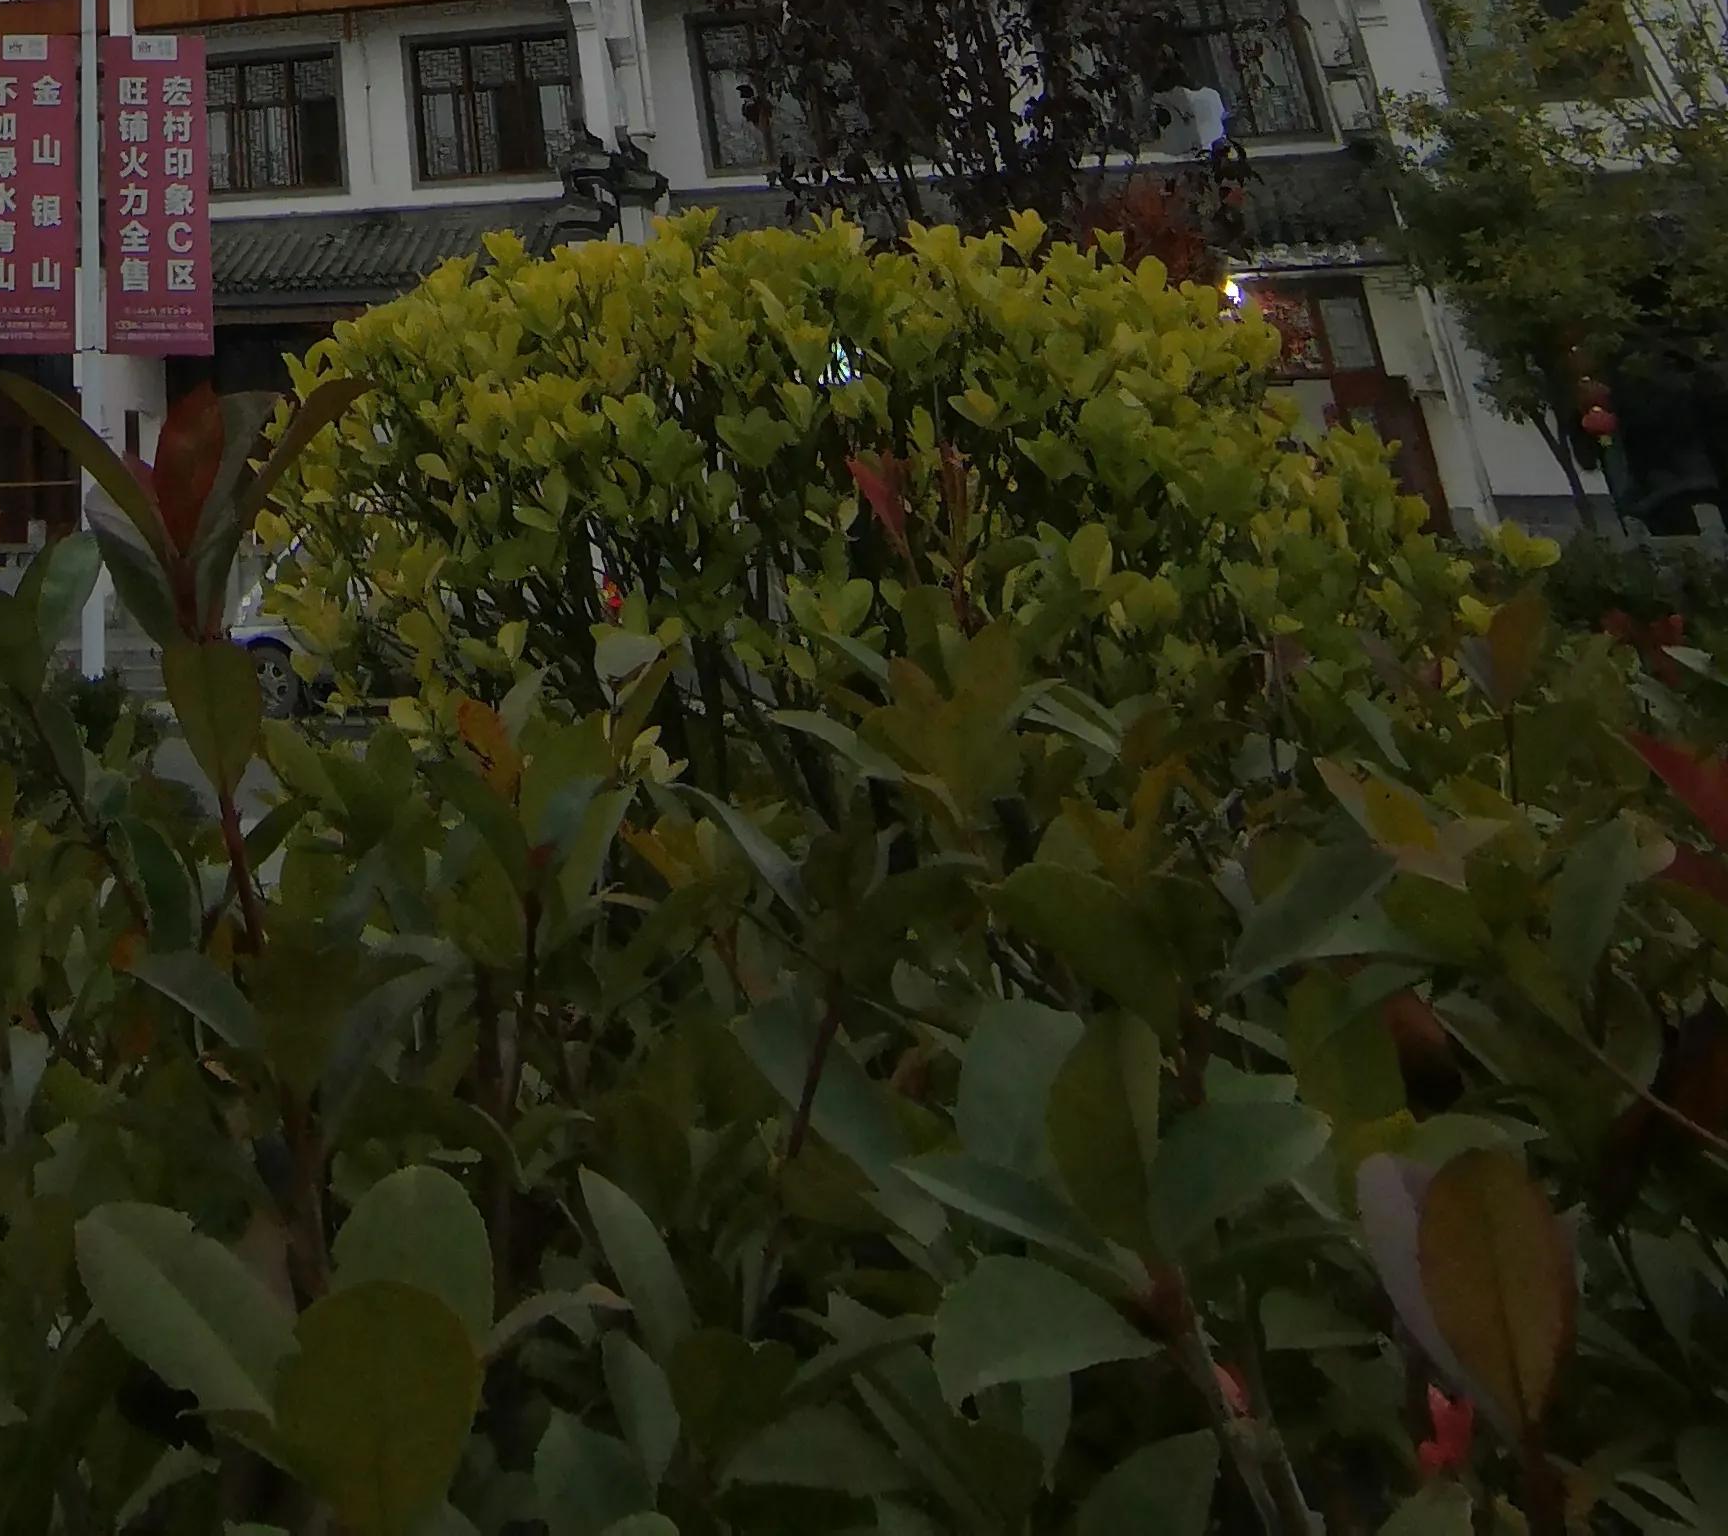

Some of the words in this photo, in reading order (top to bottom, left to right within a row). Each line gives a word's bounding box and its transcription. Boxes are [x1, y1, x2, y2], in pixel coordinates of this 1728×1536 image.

[31, 75, 63, 291] 金山银山
[118, 76, 151, 292] 旺铺火力全售
[162, 75, 196, 291] 宏村印象C区
